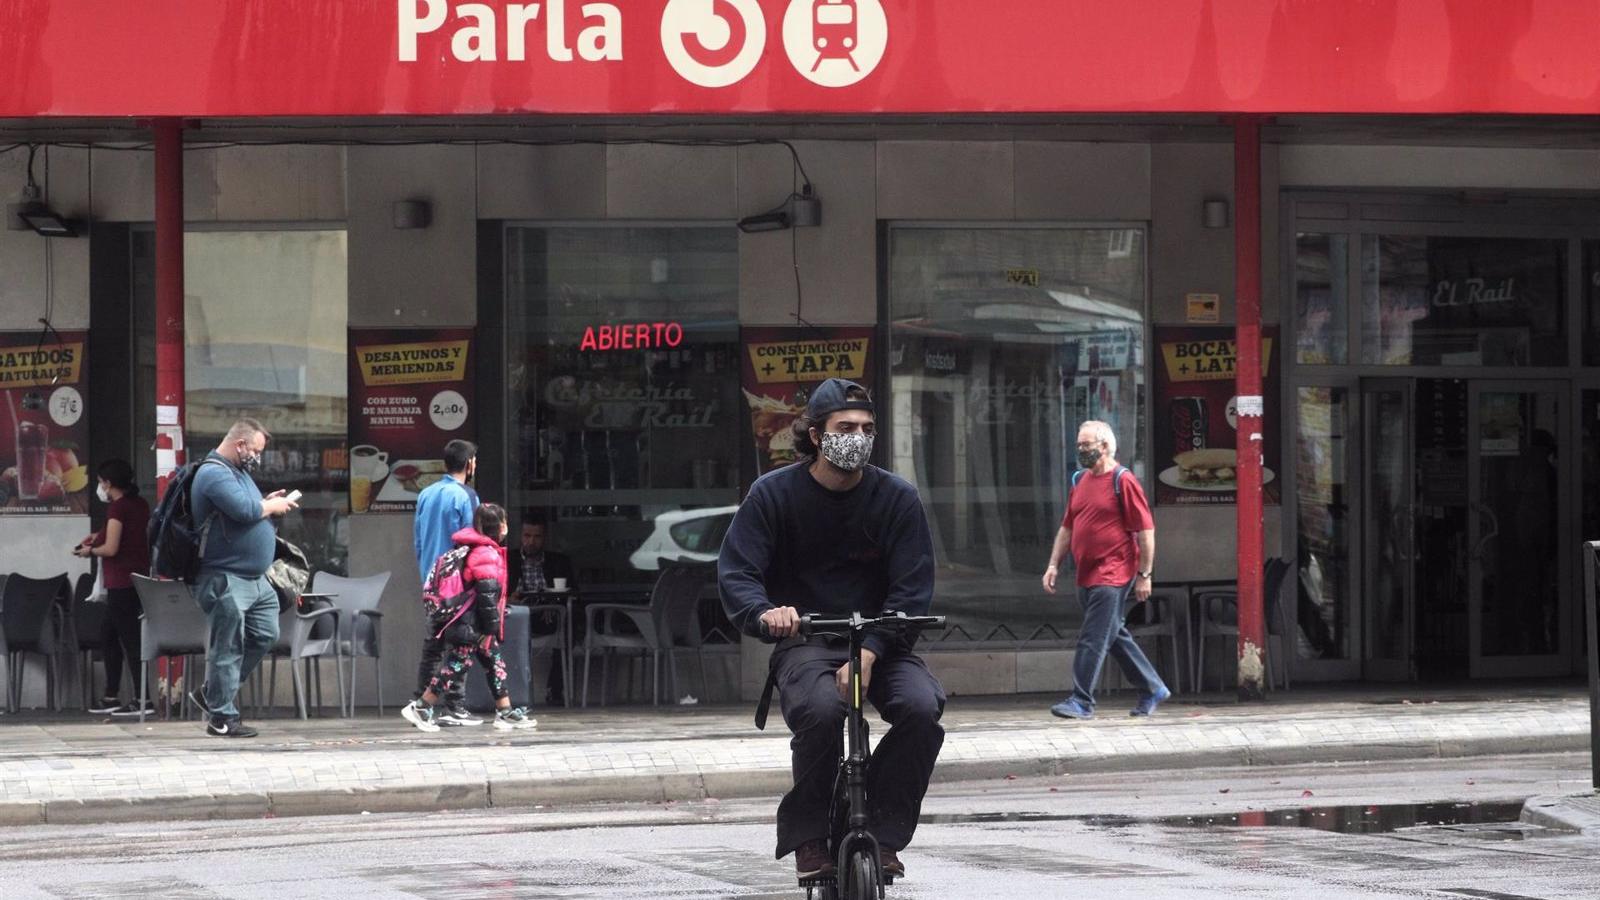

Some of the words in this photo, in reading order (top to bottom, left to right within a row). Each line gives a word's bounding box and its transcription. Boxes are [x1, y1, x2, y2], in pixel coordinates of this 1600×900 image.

[398, 0, 623, 62] Parla
[1433, 280, 1456, 307] El
[1466, 277, 1515, 304] Rail
[580, 322, 684, 351] ABIERTO
[364, 348, 449, 363] DESAYUNOS
[450, 347, 462, 358] Y
[757, 340, 862, 357] CONSUMICIÓN
[1175, 342, 1238, 358] BOCA
[371, 361, 455, 376] MERIENDAS
[782, 354, 855, 374] TAPA
[1195, 357, 1237, 373] LAT
[367, 397, 386, 405] CON
[388, 396, 417, 405] ZUMO
[362, 407, 378, 415] DE
[379, 406, 422, 415] NARANJA
[638, 399, 715, 428] Rail
[369, 417, 415, 425] NATURAL
